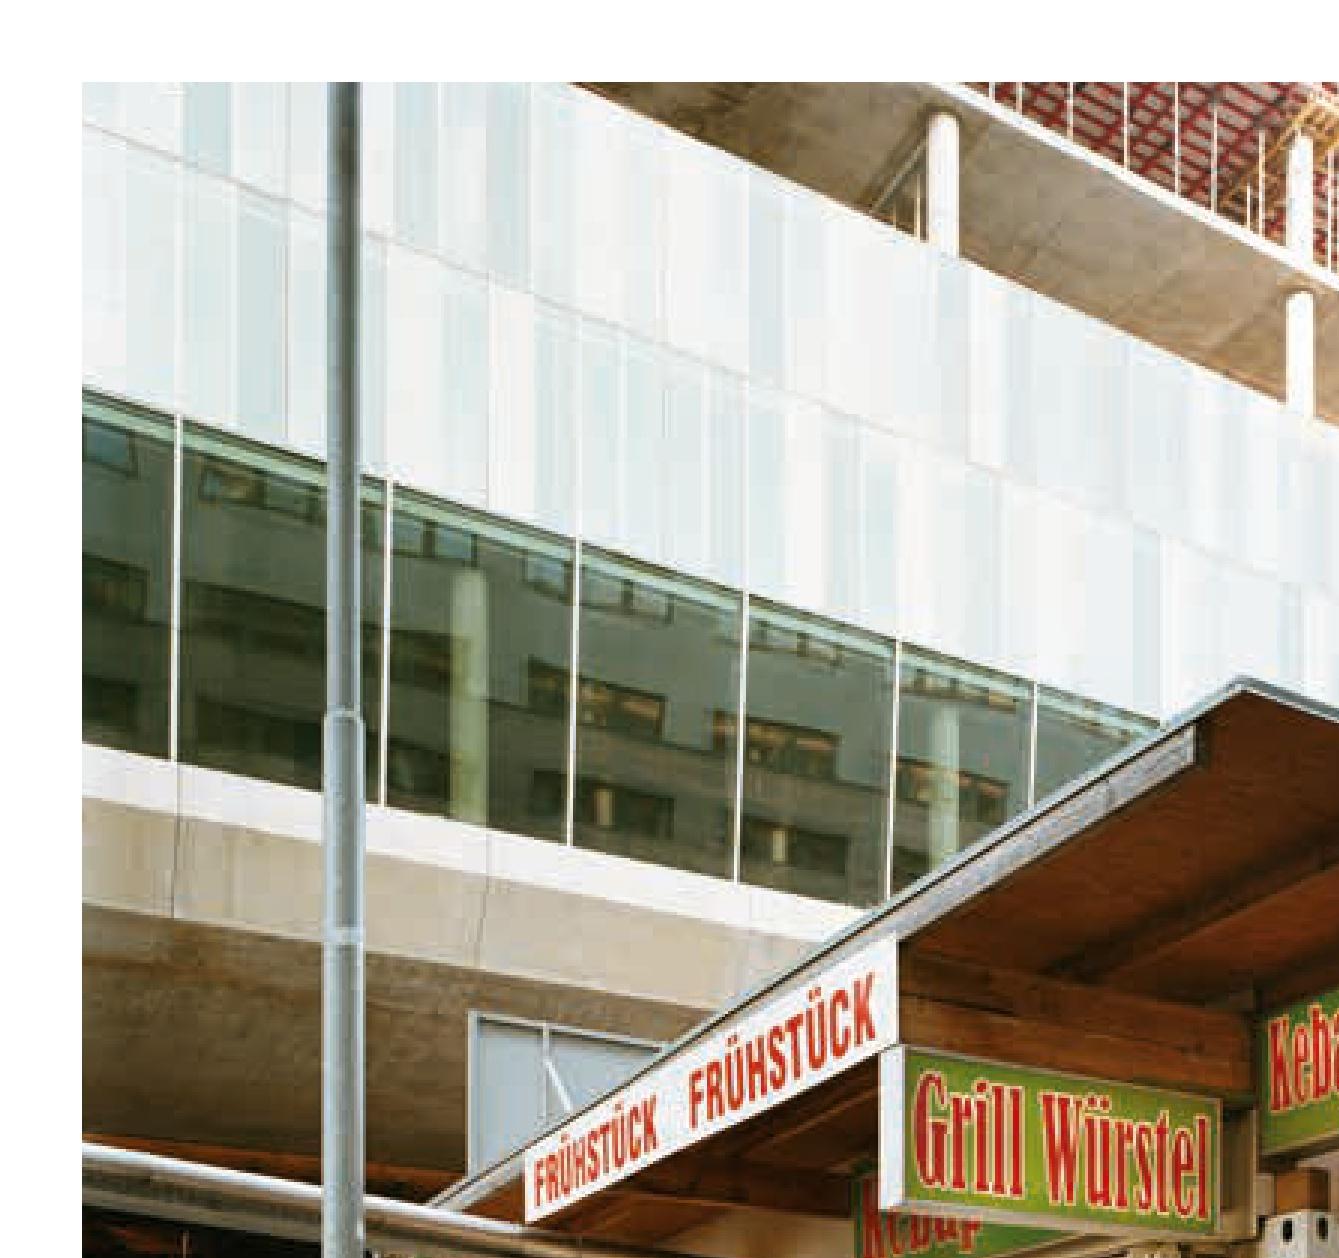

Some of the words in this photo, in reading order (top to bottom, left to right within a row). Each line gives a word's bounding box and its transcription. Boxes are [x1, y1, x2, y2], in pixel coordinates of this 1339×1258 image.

[534, 1091, 657, 1207] FRÜHSTÜCK
[688, 971, 877, 1130] FRÜHSTÜCK
[914, 1072, 1026, 1199] Grill
[1040, 1092, 1212, 1222] Würstel
